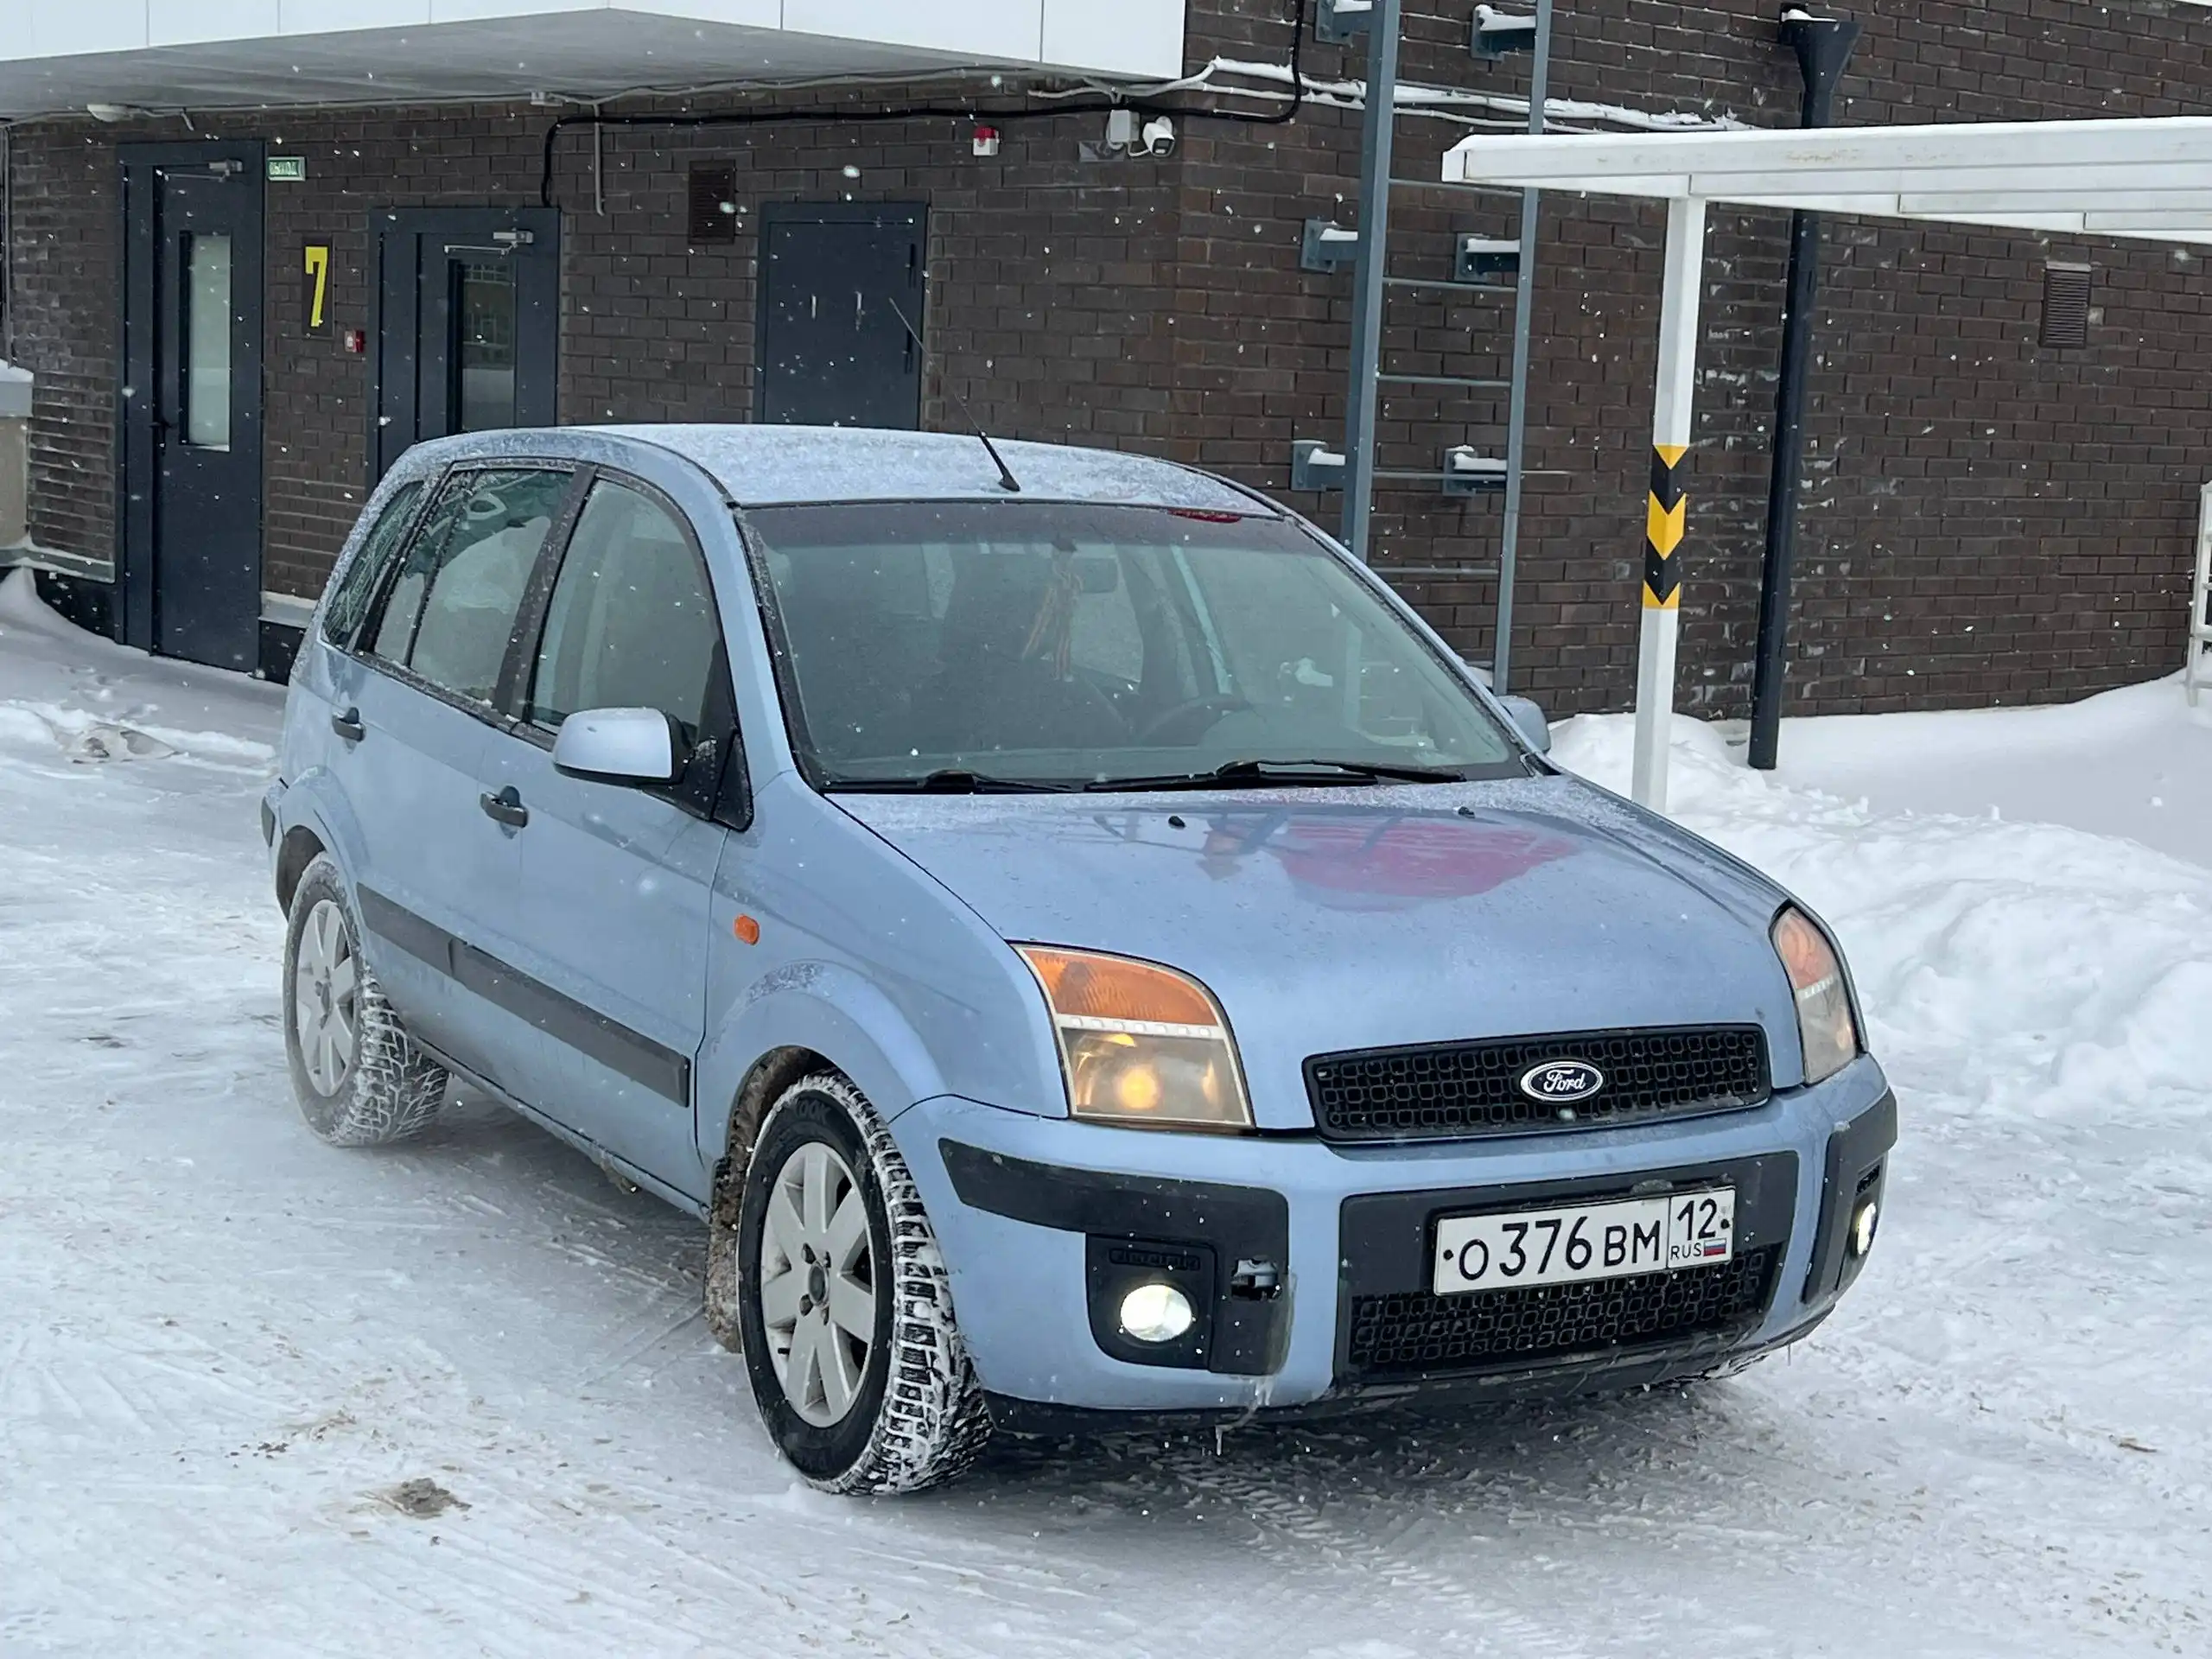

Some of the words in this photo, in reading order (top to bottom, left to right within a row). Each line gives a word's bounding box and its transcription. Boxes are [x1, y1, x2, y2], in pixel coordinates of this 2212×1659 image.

[305, 246, 328, 327] 7
[1543, 1069, 1586, 1092] Ford
[1677, 1198, 1717, 1242] 12
[1670, 1243, 1702, 1260] RUS
